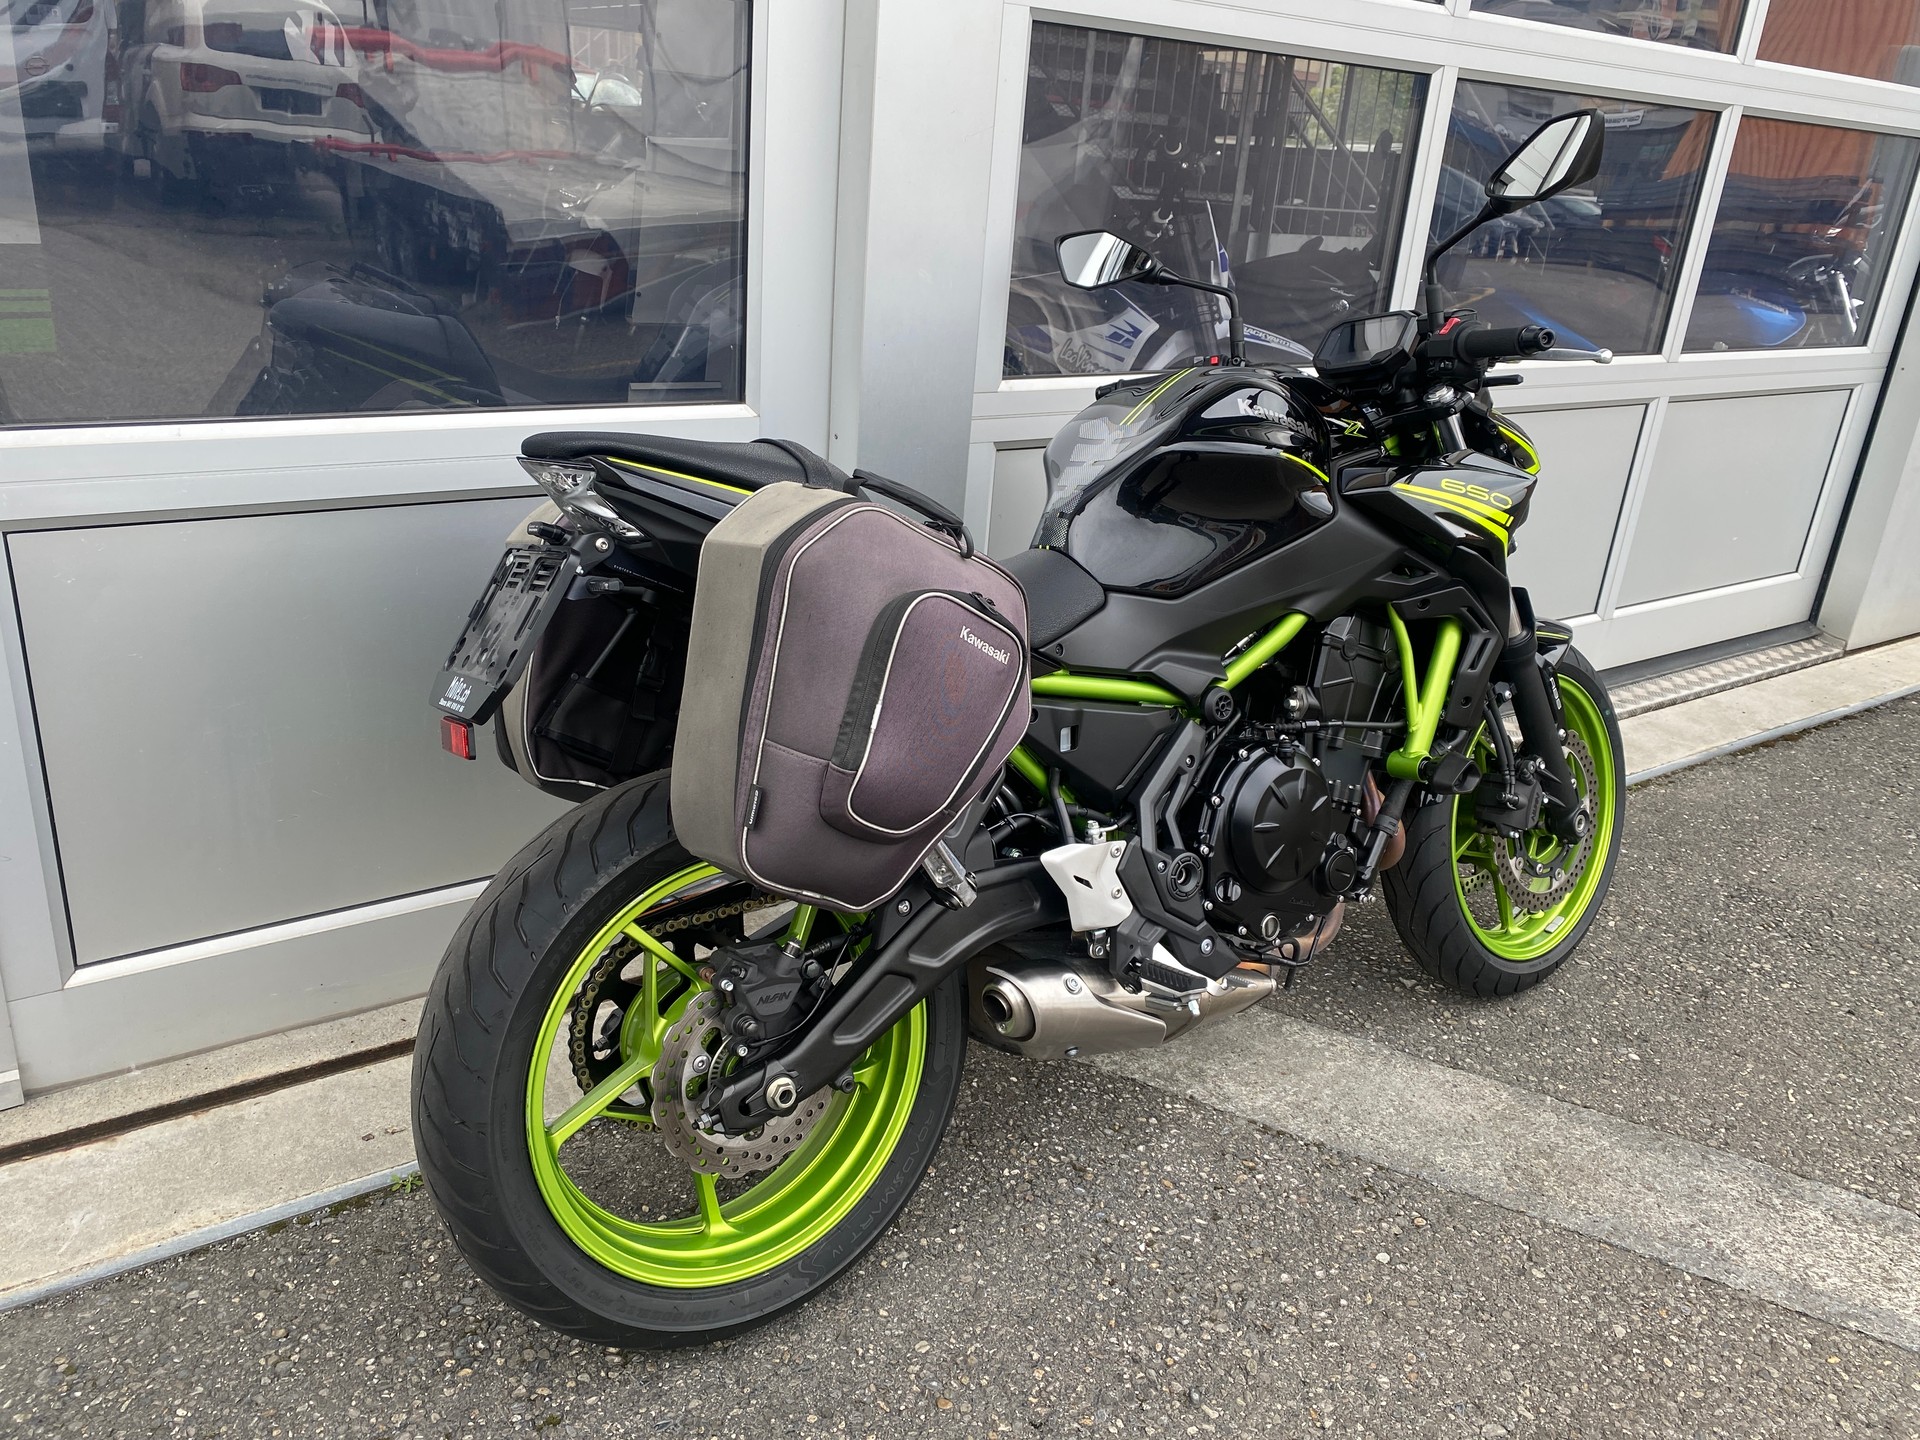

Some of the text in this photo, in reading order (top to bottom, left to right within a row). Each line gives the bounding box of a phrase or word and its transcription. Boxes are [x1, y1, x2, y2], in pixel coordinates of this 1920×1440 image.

[1237, 398, 1318, 440] Kawasaki
[1440, 478, 1513, 510] 650
[959, 625, 1011, 665] Kawasaki
